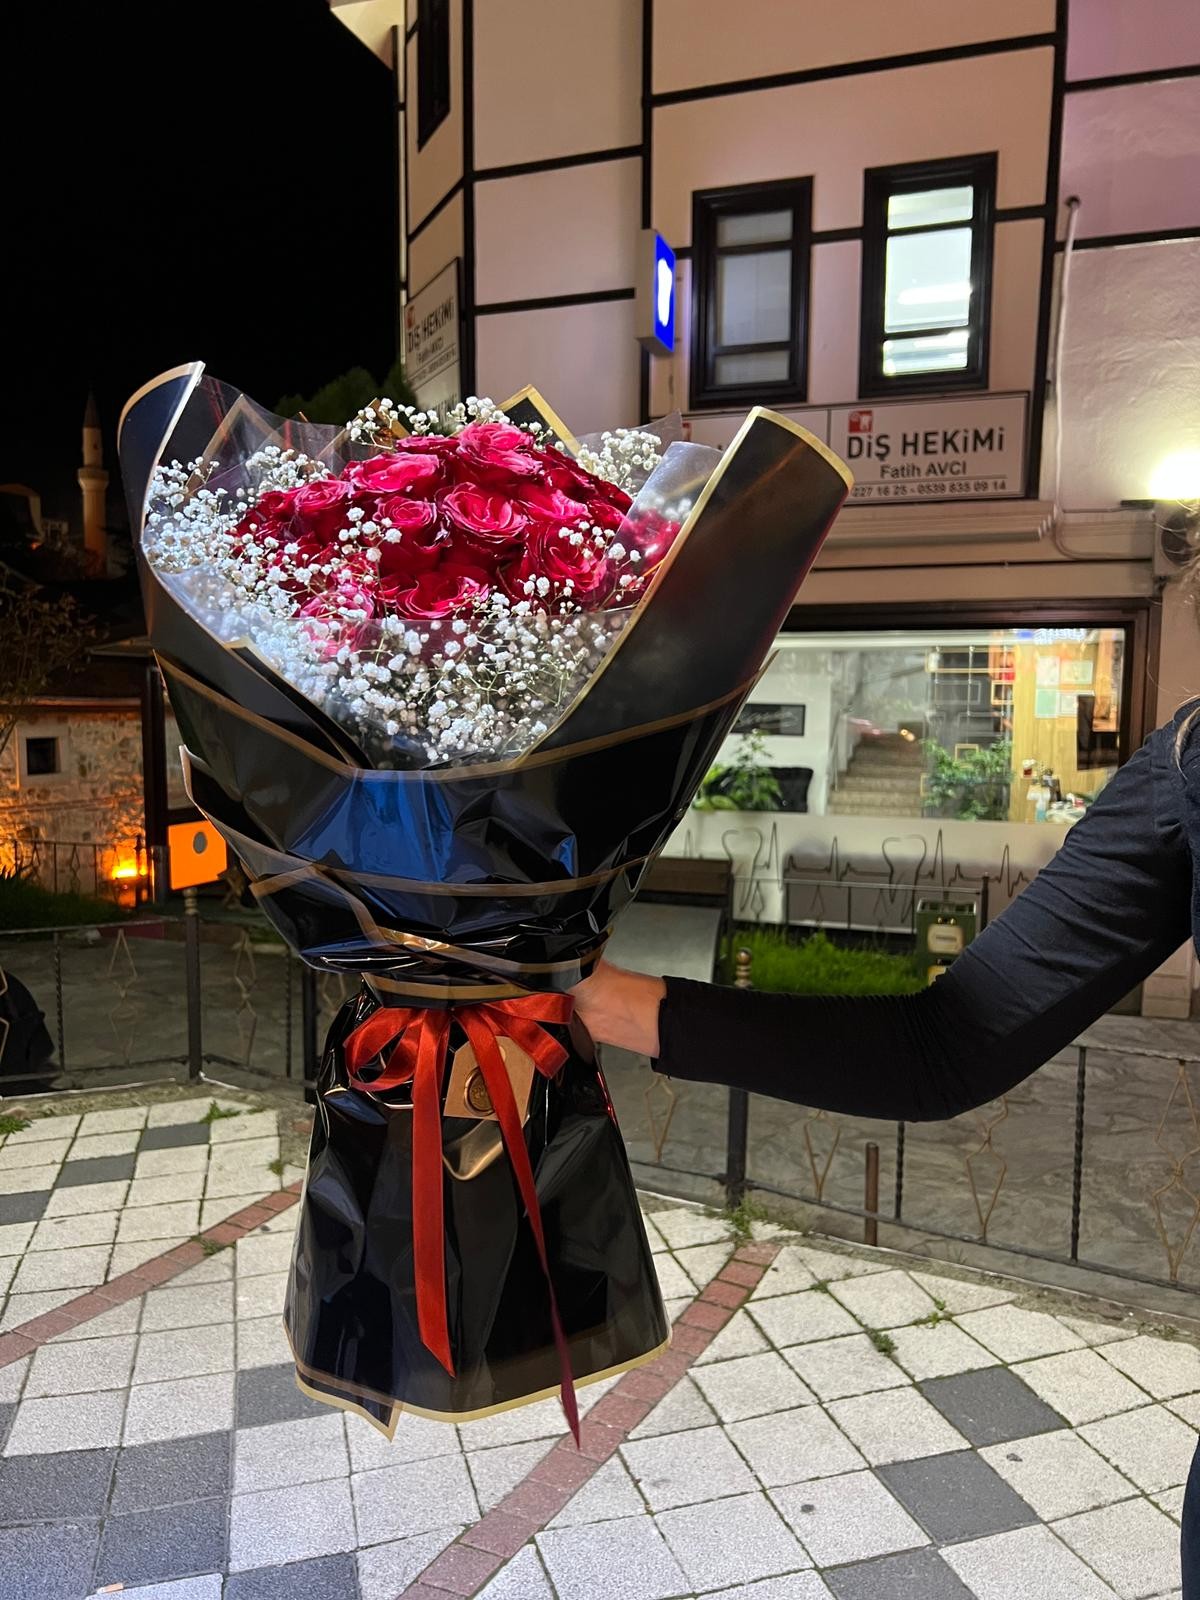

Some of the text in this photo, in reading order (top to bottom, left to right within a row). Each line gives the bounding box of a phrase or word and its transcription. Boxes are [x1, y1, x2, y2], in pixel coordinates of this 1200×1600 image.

[847, 426, 1005, 461] DİŞ HEKİMİ
[880, 461, 967, 479] Fatih AVCI
